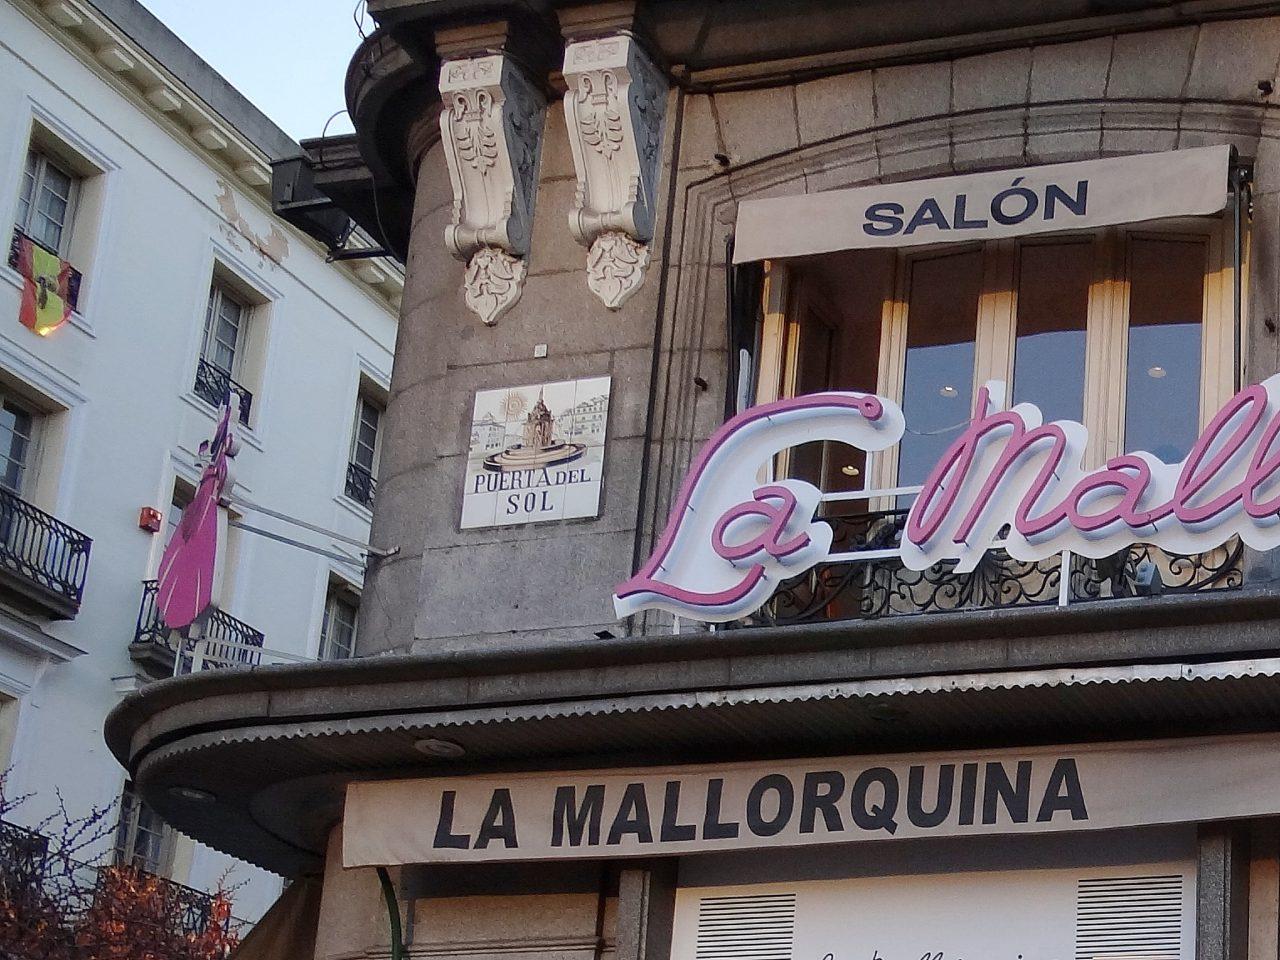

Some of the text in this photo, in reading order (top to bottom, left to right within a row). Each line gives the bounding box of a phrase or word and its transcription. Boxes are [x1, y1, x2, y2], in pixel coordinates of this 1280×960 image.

[862, 176, 1089, 237] SALÓN
[474, 468, 591, 493] PUERTA DEL
[506, 490, 553, 515] SOL
[616, 390, 883, 606] La
[431, 757, 1089, 850] LA MALLORQUINA
